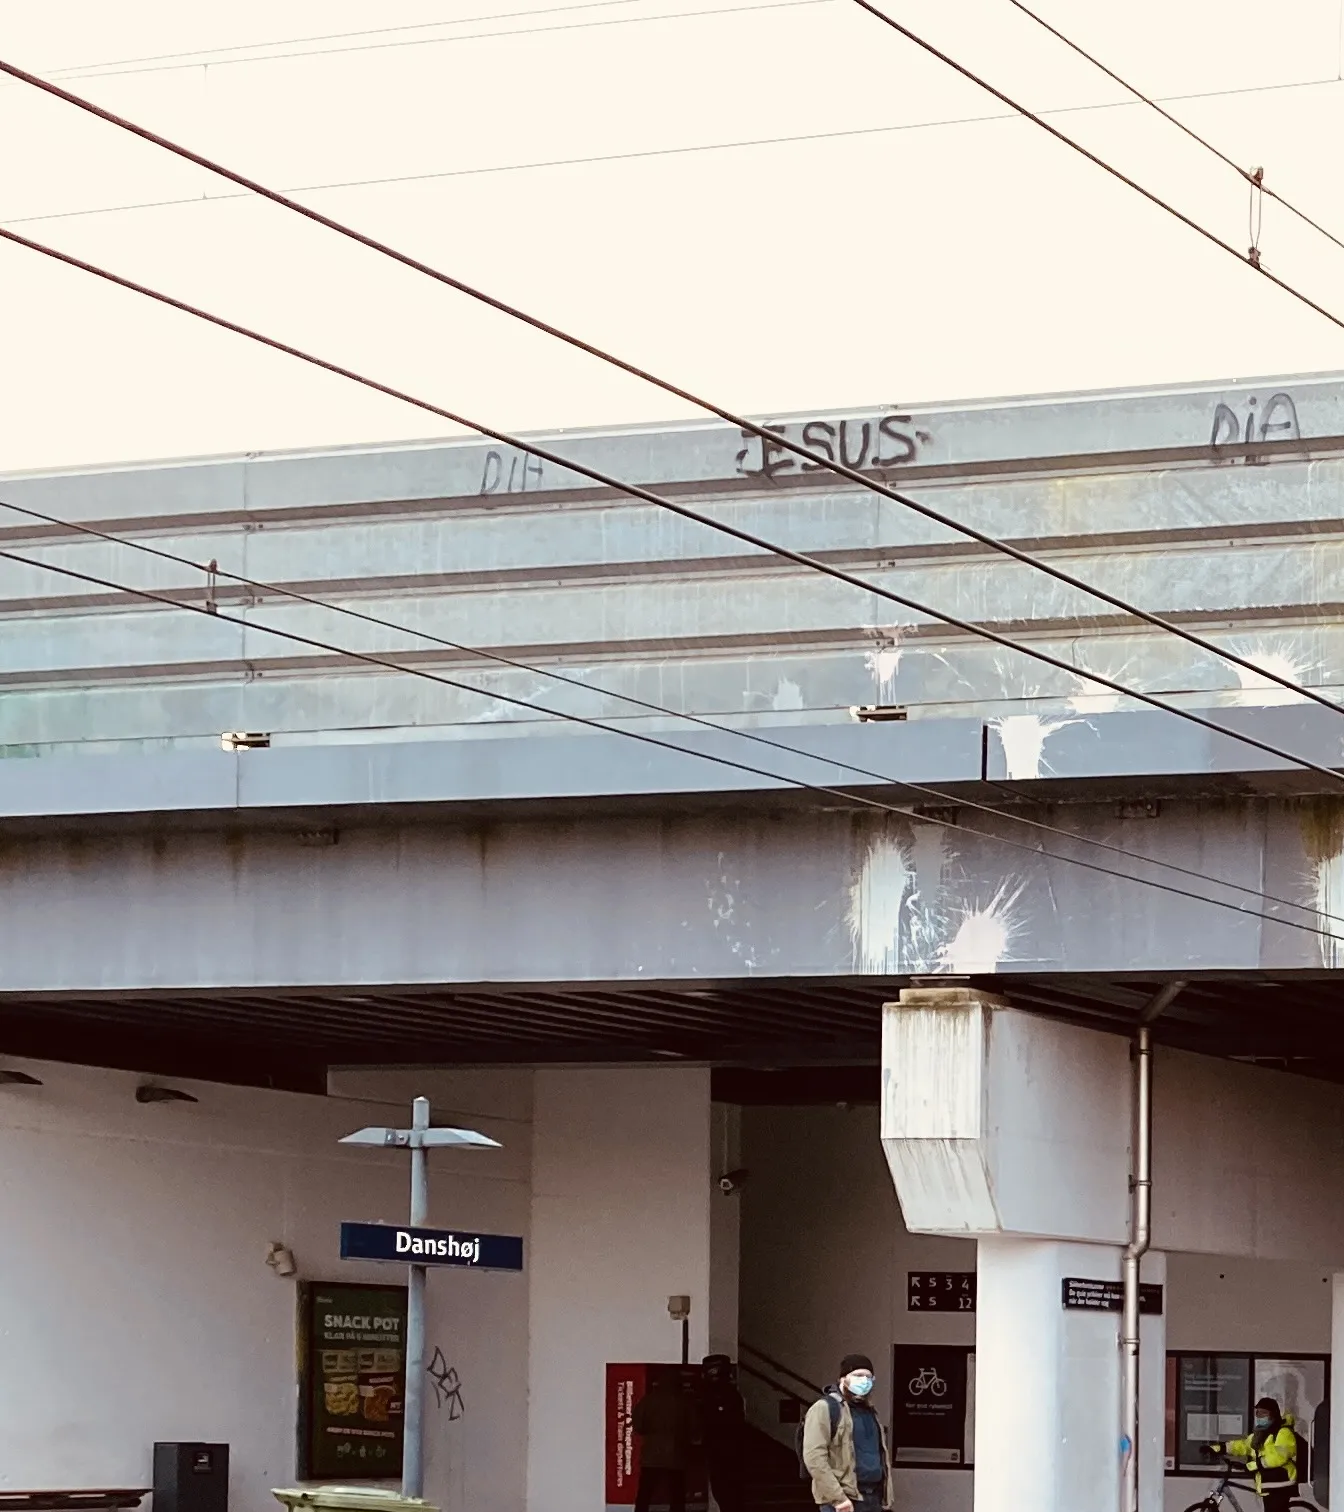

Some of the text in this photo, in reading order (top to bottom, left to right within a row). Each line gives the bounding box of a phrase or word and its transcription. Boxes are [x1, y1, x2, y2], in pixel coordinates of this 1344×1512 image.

[395, 1231, 480, 1263] Danshøj
[944, 1278, 953, 1291] 3
[961, 1279, 969, 1291] 4
[324, 1314, 400, 1331] SNACK POT
